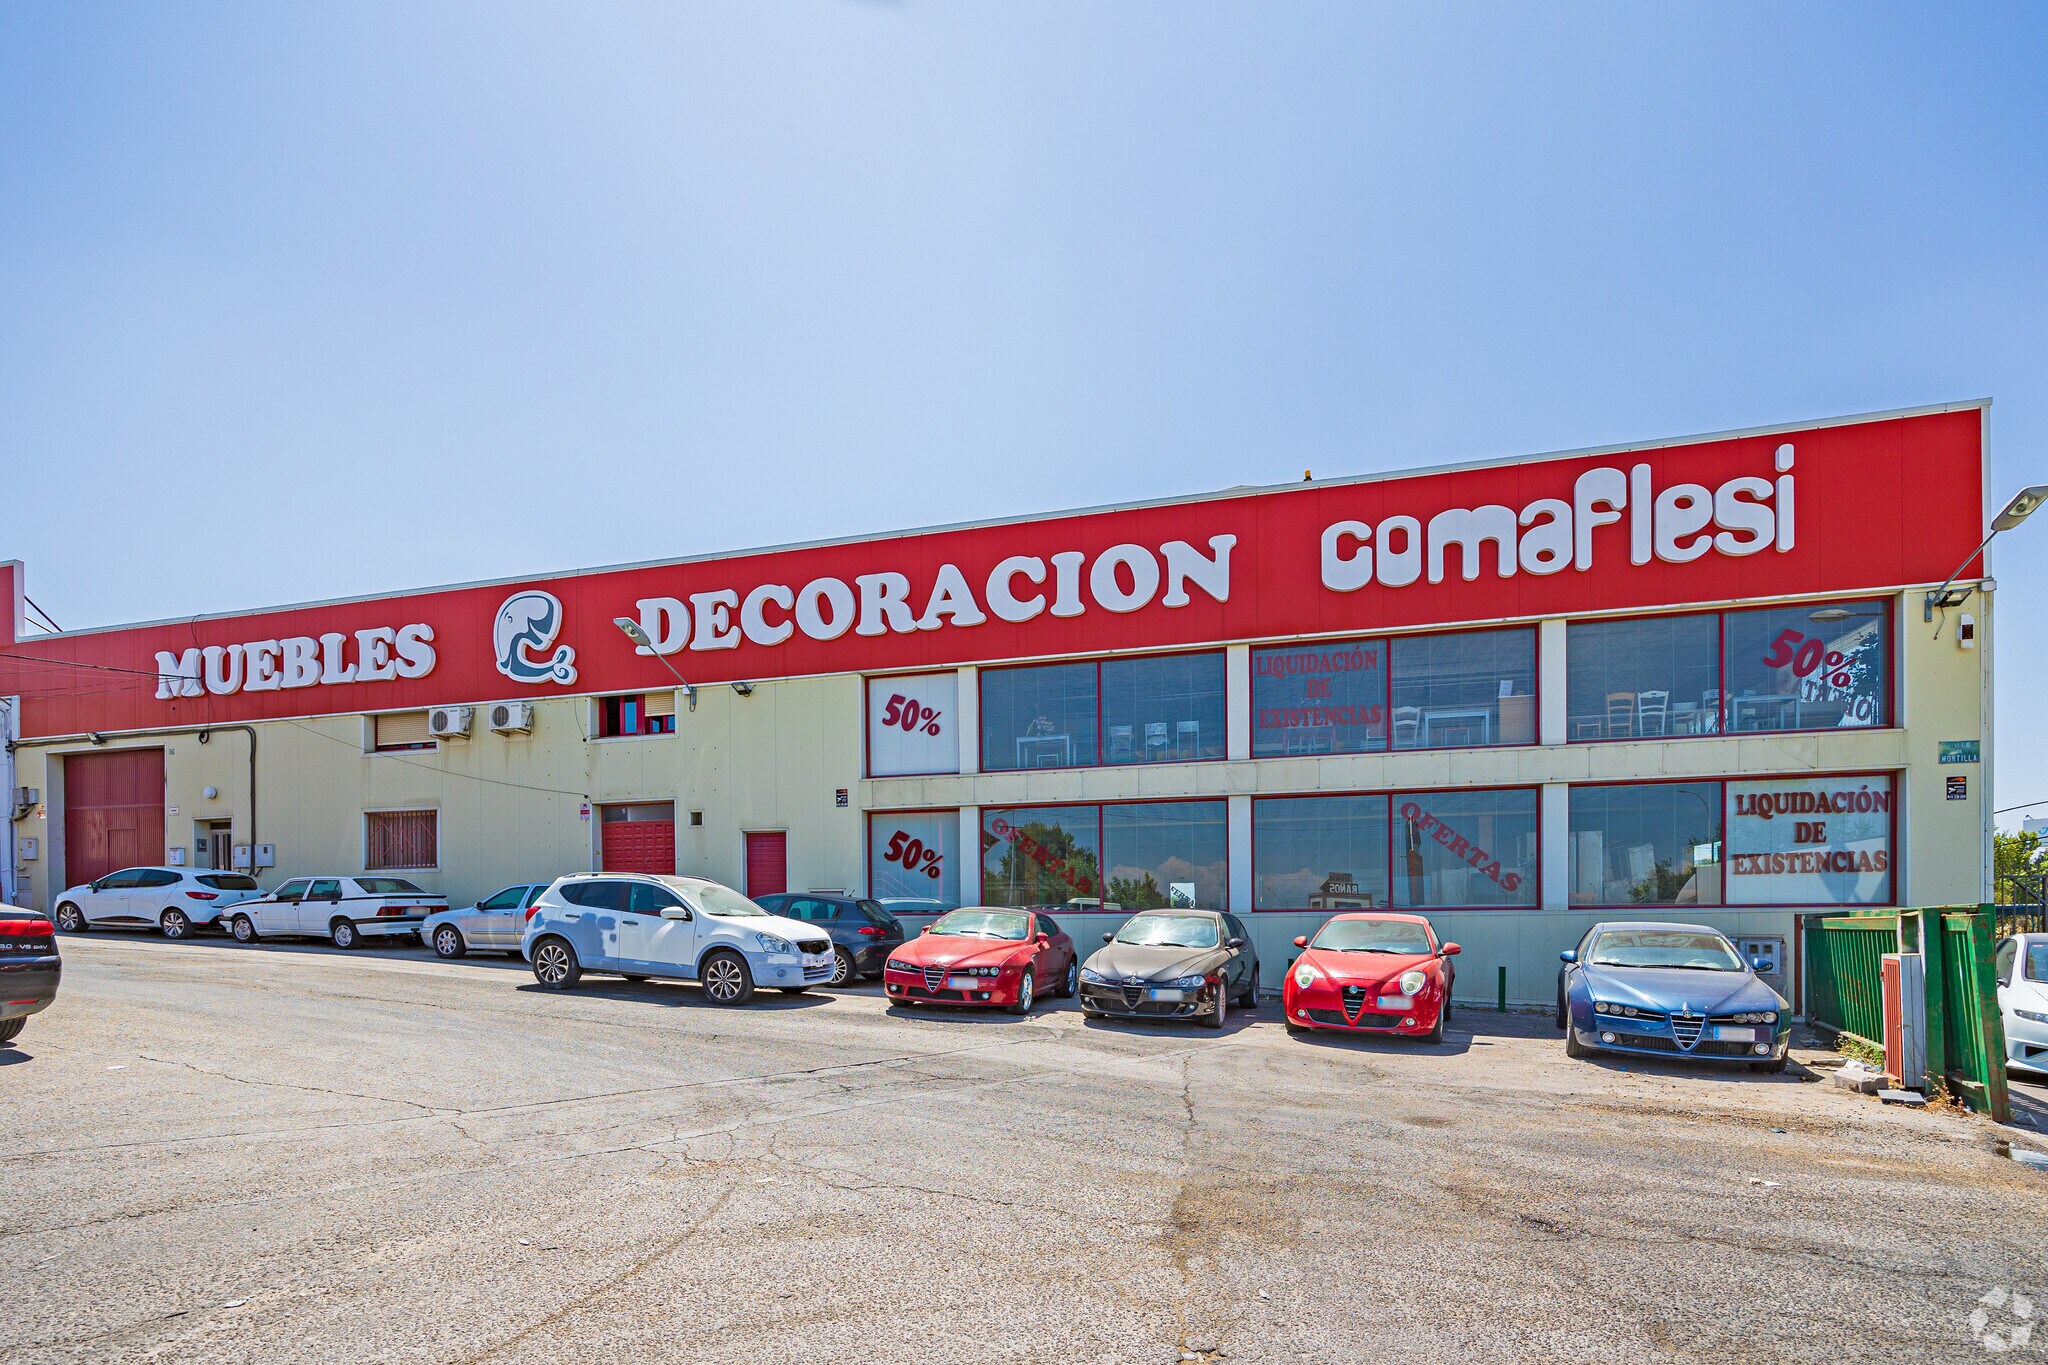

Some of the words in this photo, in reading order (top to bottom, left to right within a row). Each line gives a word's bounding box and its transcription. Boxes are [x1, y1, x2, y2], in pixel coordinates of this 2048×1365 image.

[1320, 443, 1795, 592] comaflesi
[154, 622, 436, 700] MUEBLES
[634, 533, 1238, 657] DECORACION
[1255, 645, 1378, 679] LIQUIDACIÓN
[1763, 628, 1852, 688] 50%
[1306, 678, 1333, 698] DE
[882, 693, 942, 737] 50%
[1259, 704, 1382, 729] EXISTENCIAS
[1941, 754, 1978, 763] MONTILLA
[1735, 784, 1892, 820] LIQUIDACIÓN
[1400, 802, 1523, 892] OFERTAS
[1794, 821, 1827, 844] DE
[884, 829, 944, 879] 50%
[991, 817, 1094, 895] OFERTAS
[1732, 850, 1888, 875] EXISTENCIAS
